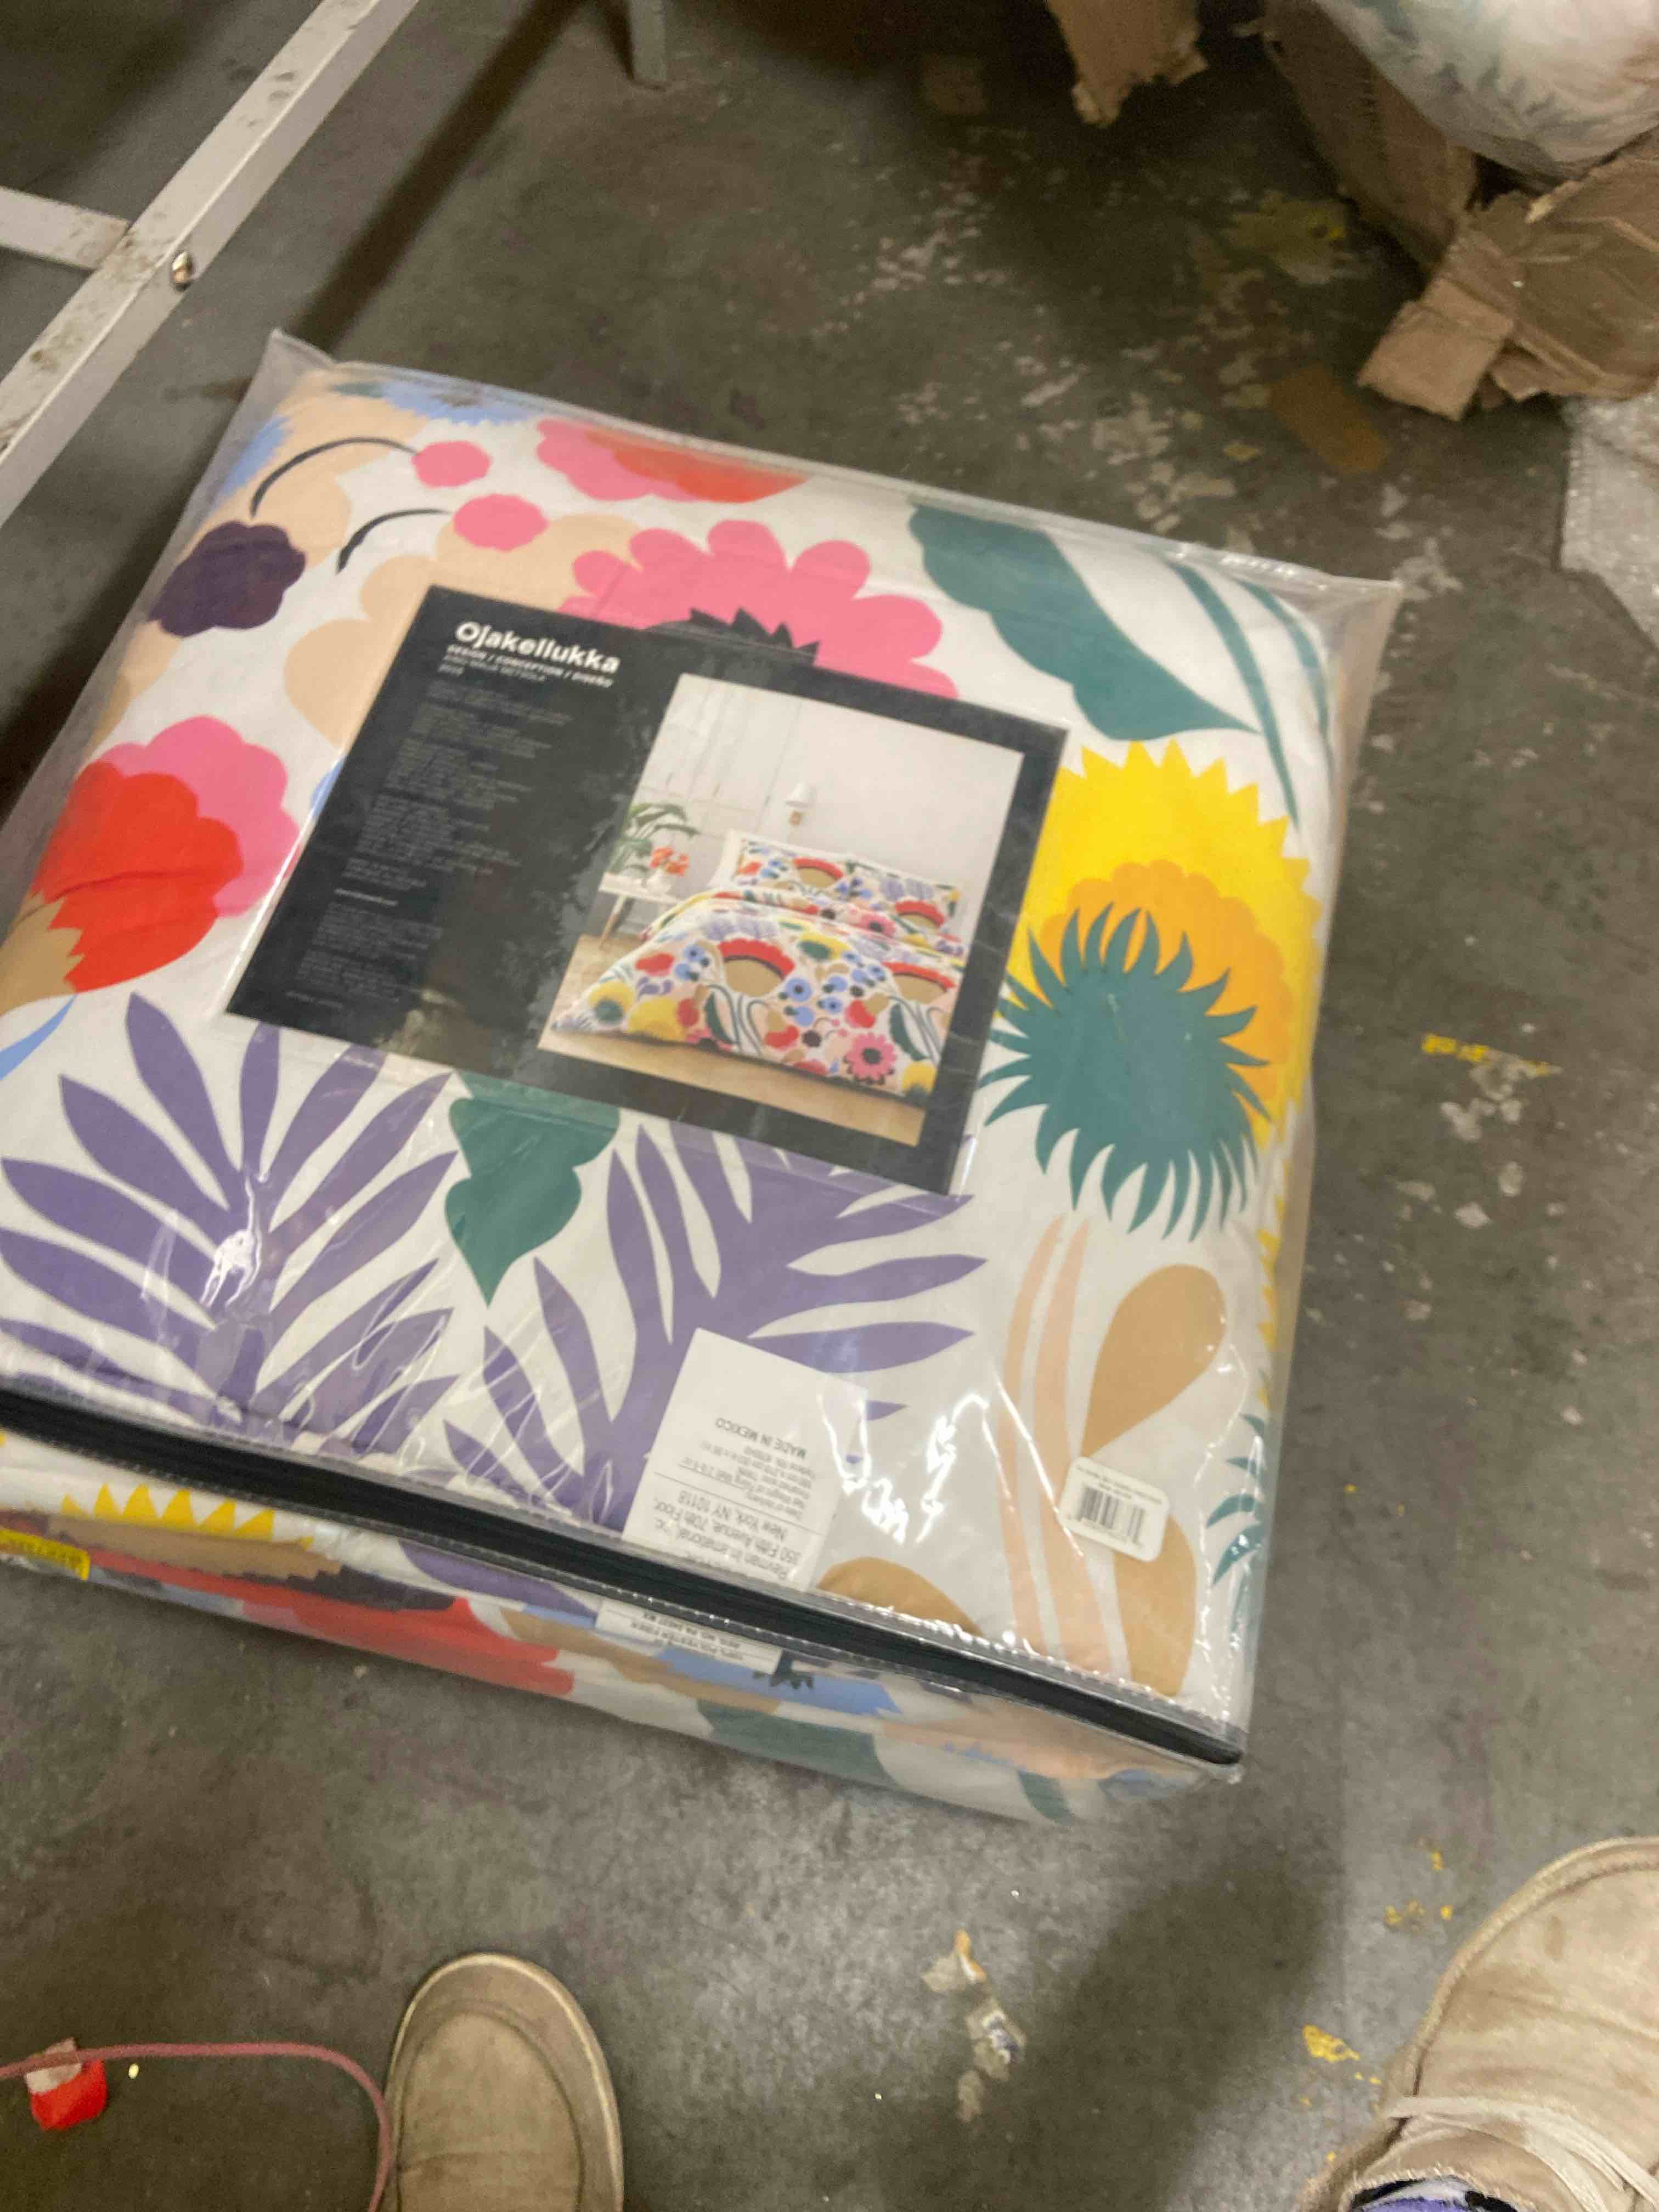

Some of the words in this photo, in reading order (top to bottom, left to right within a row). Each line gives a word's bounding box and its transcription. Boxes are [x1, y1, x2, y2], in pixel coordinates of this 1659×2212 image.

[715, 1416, 759, 1442] MEXICO
[761, 1433, 772, 1448] IN
[774, 1438, 808, 1460] MADE
[712, 1505, 732, 1522] NY
[761, 1522, 788, 1543] New
